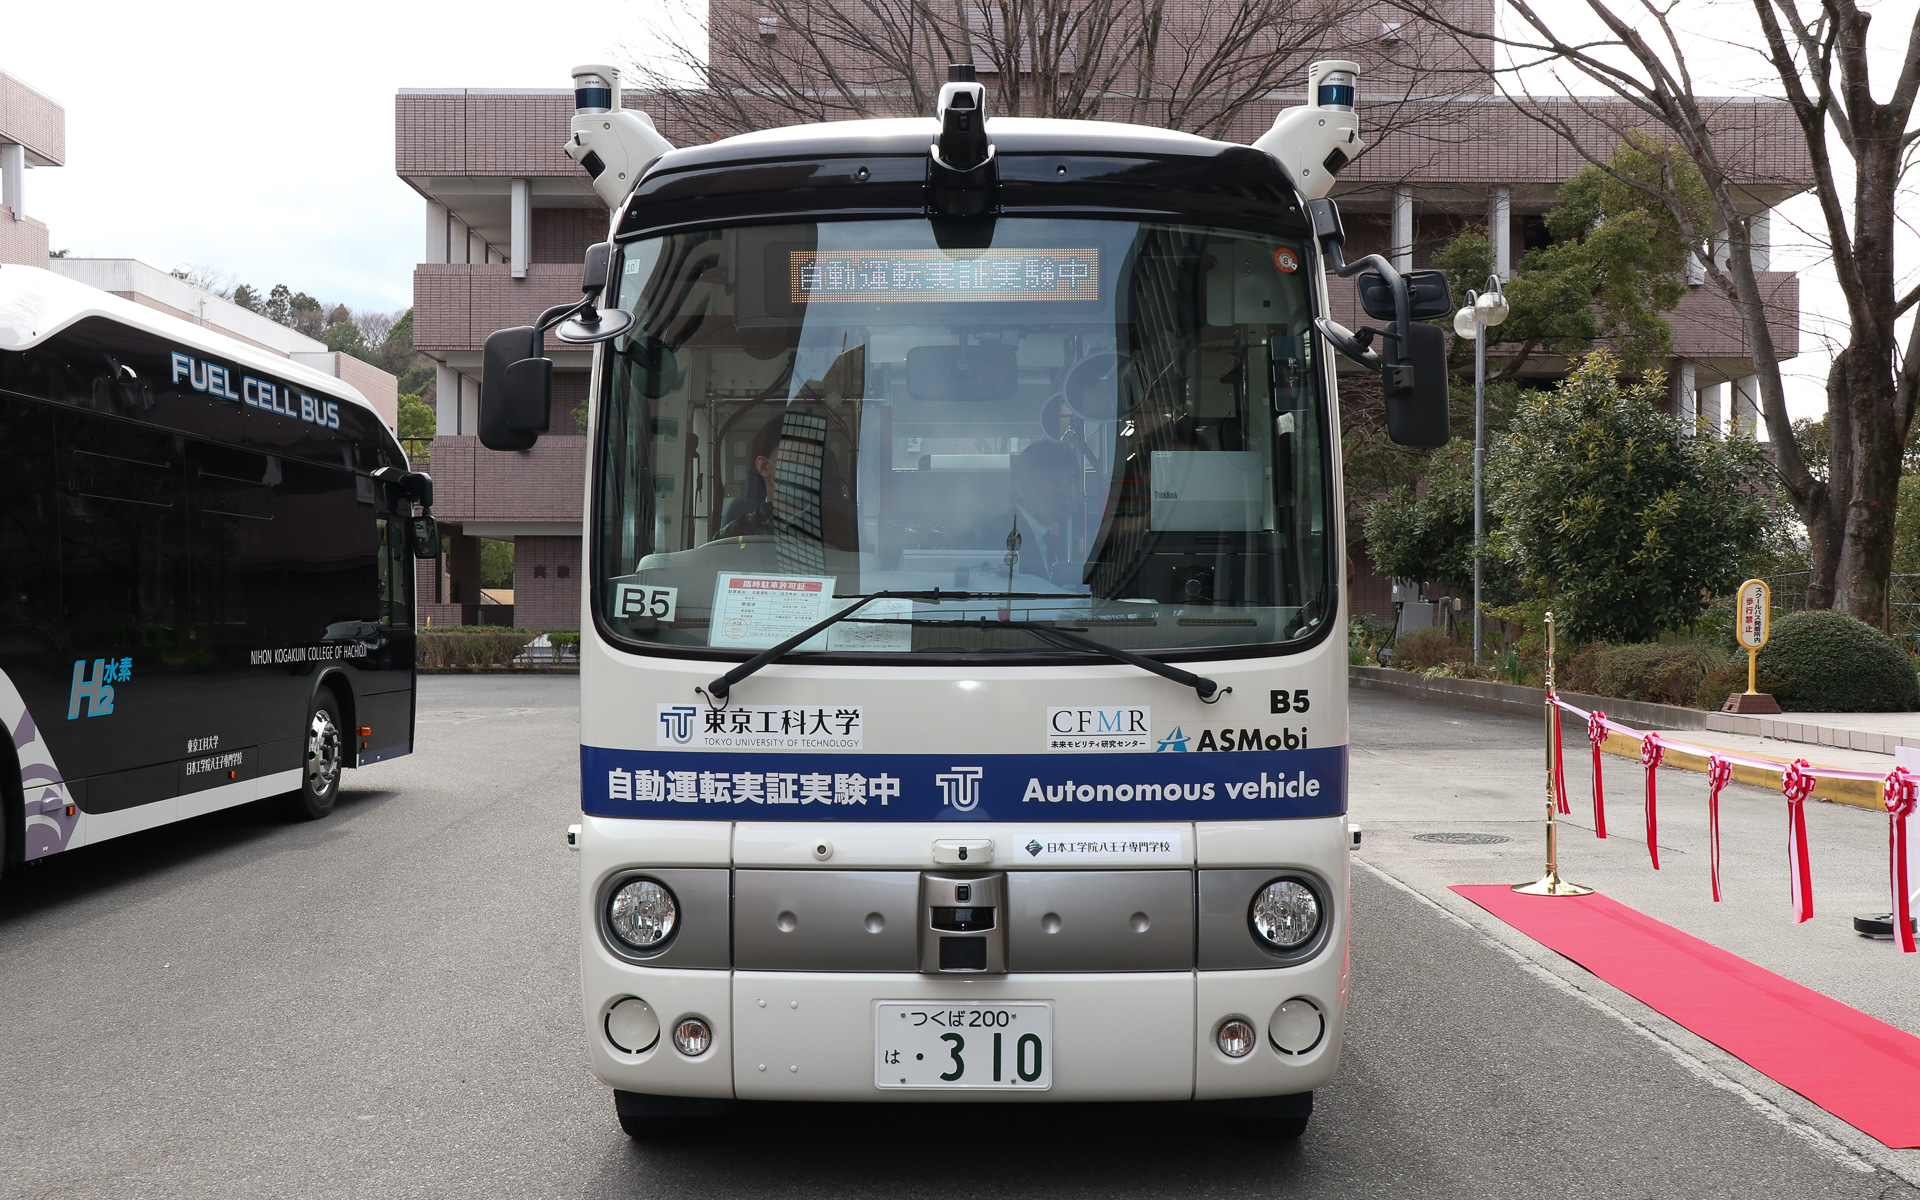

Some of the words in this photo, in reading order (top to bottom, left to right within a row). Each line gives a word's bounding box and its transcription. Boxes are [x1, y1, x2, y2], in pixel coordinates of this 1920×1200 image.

[800, 258, 1088, 290] 自動運転実証実験中
[171, 351, 240, 402] FUEL
[243, 375, 298, 419] CELL
[300, 392, 341, 430] BUS
[1154, 491, 1178, 500] ThinkBook
[742, 580, 807, 592] 臨時駐車許可証
[620, 588, 670, 618] B5
[1745, 597, 1754, 633] 歩行禁止
[1753, 587, 1763, 643] スクールバス発着所内
[250, 649, 272, 665] NIHON
[274, 647, 306, 664] KOGAKUIN
[307, 645, 334, 661] COLLEGE
[334, 645, 343, 659] OF
[343, 644, 367, 658] HACHIOJI
[103, 656, 133, 684] 水素
[68, 659, 115, 720] H2
[1270, 689, 1310, 714] B5
[703, 707, 860, 735] 東京工科大学
[1052, 709, 1148, 733] CFMR
[187, 735, 219, 753] 東京工科大学
[703, 737, 733, 746] TOKYO
[735, 738, 785, 747] UNIVERSITY
[787, 738, 798, 747] OF
[800, 738, 860, 748] TECHNOLOGY
[1050, 739, 1146, 749] 未来モビリティ研究センター
[1196, 726, 1308, 753] ASMobi
[186, 751, 243, 776] 日本工学院八王子専門学校
[608, 767, 901, 806] 自動運転実証実験中
[1022, 777, 1215, 803] Autonomous
[1225, 770, 1320, 799] vehicle
[1047, 841, 1171, 853] 日本工学院八王子専門学校
[911, 1010, 966, 1027] つくば
[969, 1010, 1010, 1027] 200
[884, 1049, 901, 1065] は
